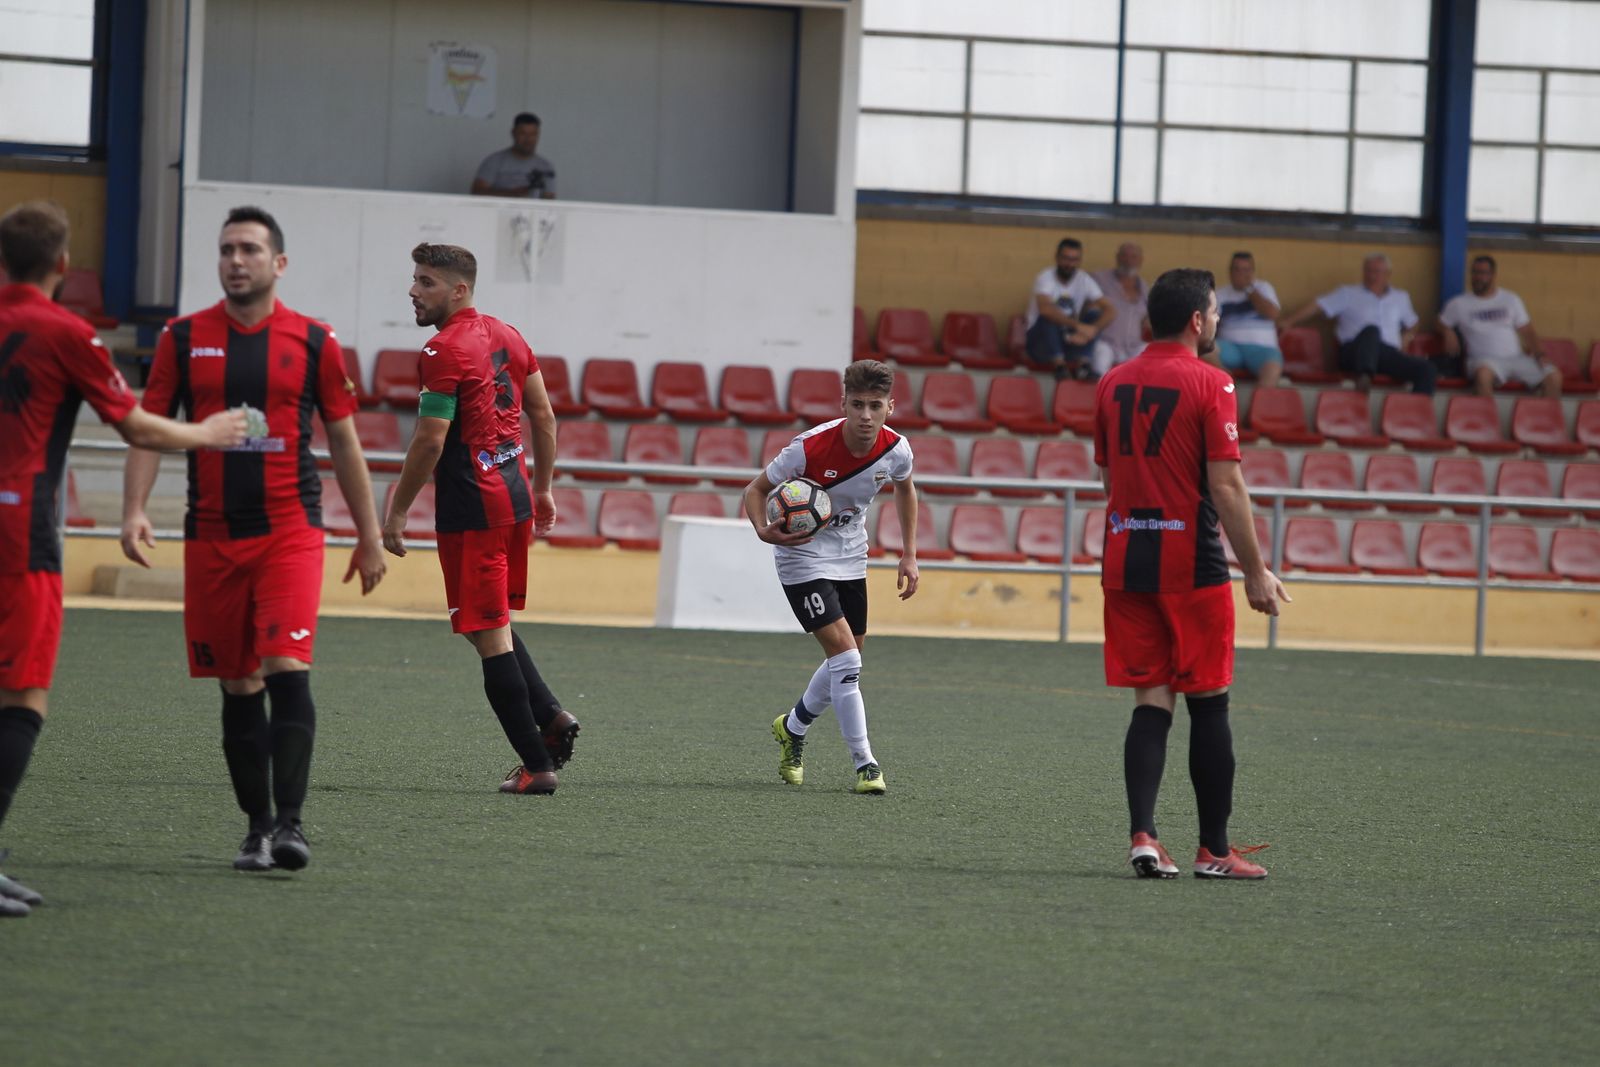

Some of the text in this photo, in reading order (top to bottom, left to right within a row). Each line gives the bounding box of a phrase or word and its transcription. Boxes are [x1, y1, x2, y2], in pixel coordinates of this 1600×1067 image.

[1114, 383, 1181, 457] 17
[803, 592, 826, 618] 19
[191, 640, 216, 668] 15
